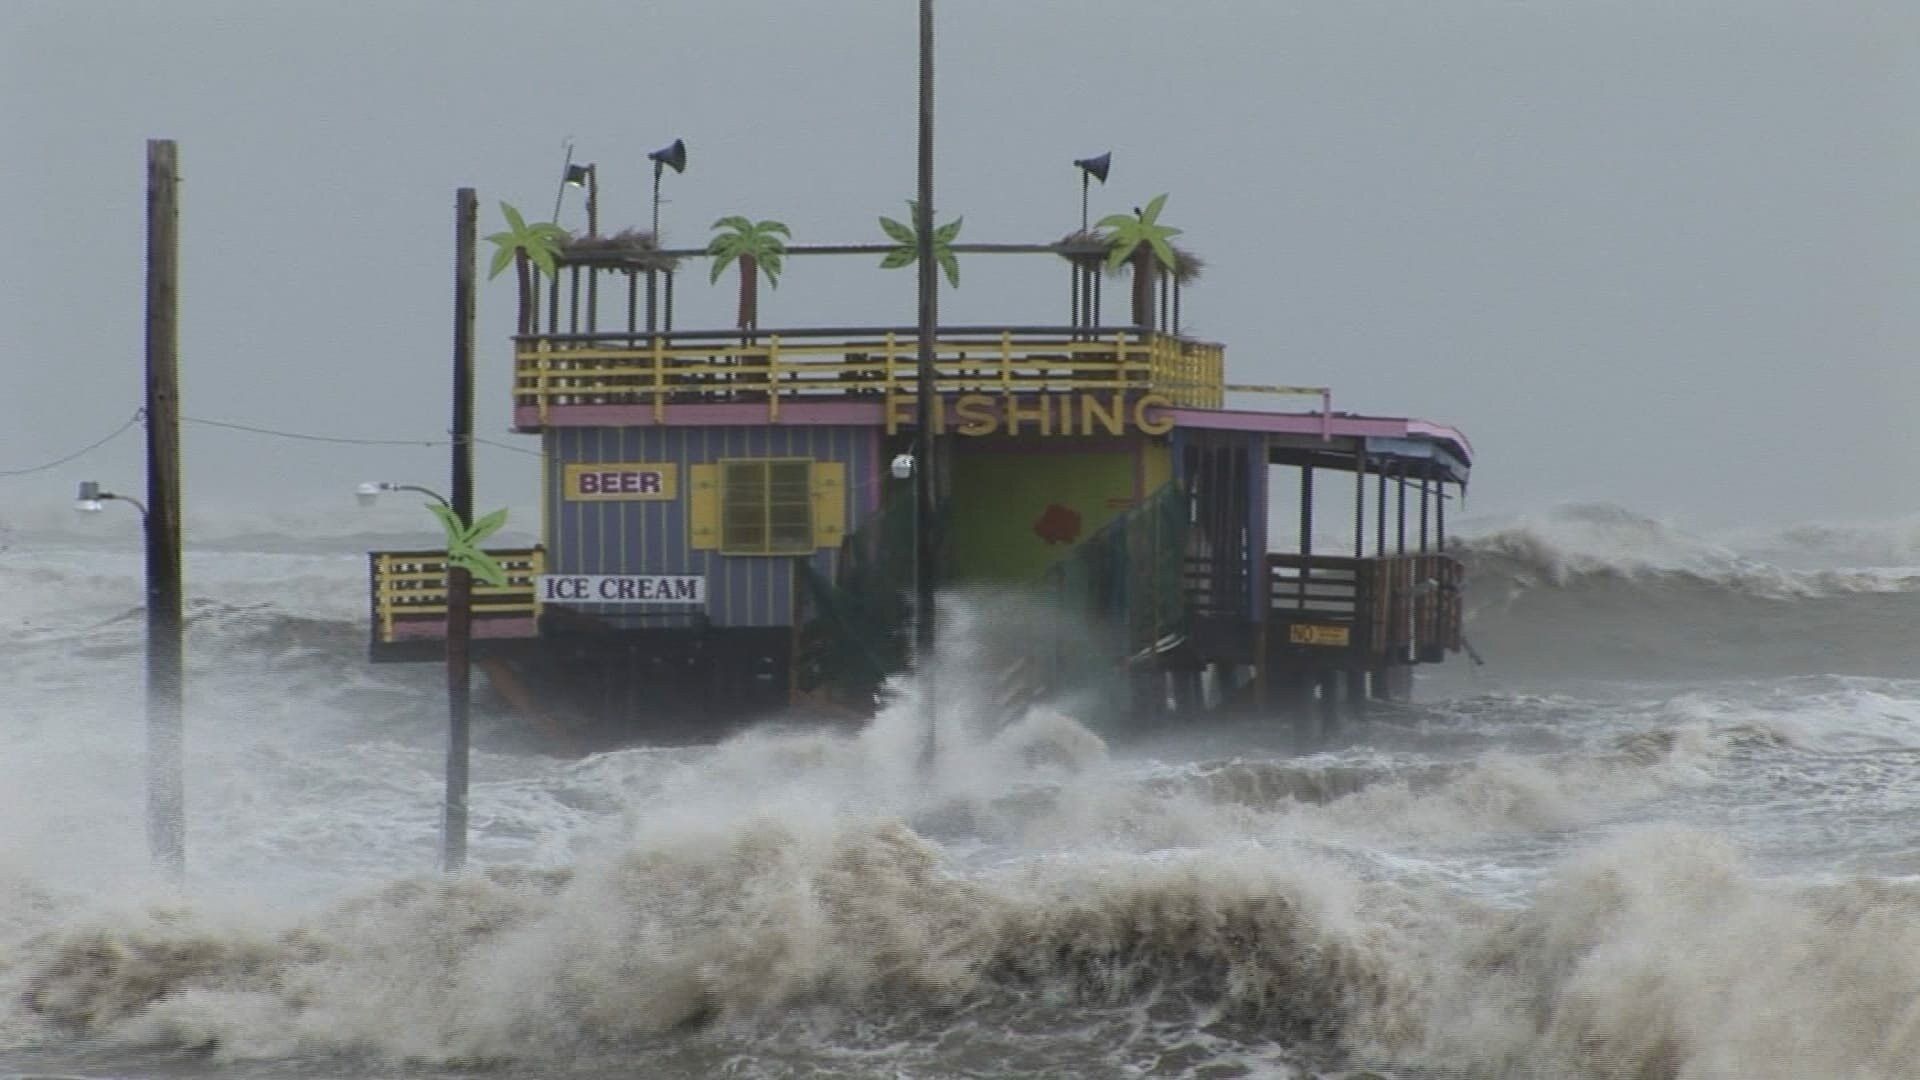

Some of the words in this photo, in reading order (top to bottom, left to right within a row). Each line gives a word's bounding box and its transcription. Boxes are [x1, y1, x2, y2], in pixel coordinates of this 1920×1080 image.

[886, 394, 1175, 435] FISHING
[579, 472, 661, 493] BEER
[548, 578, 589, 600] ICE
[599, 578, 697, 600] CREAM
